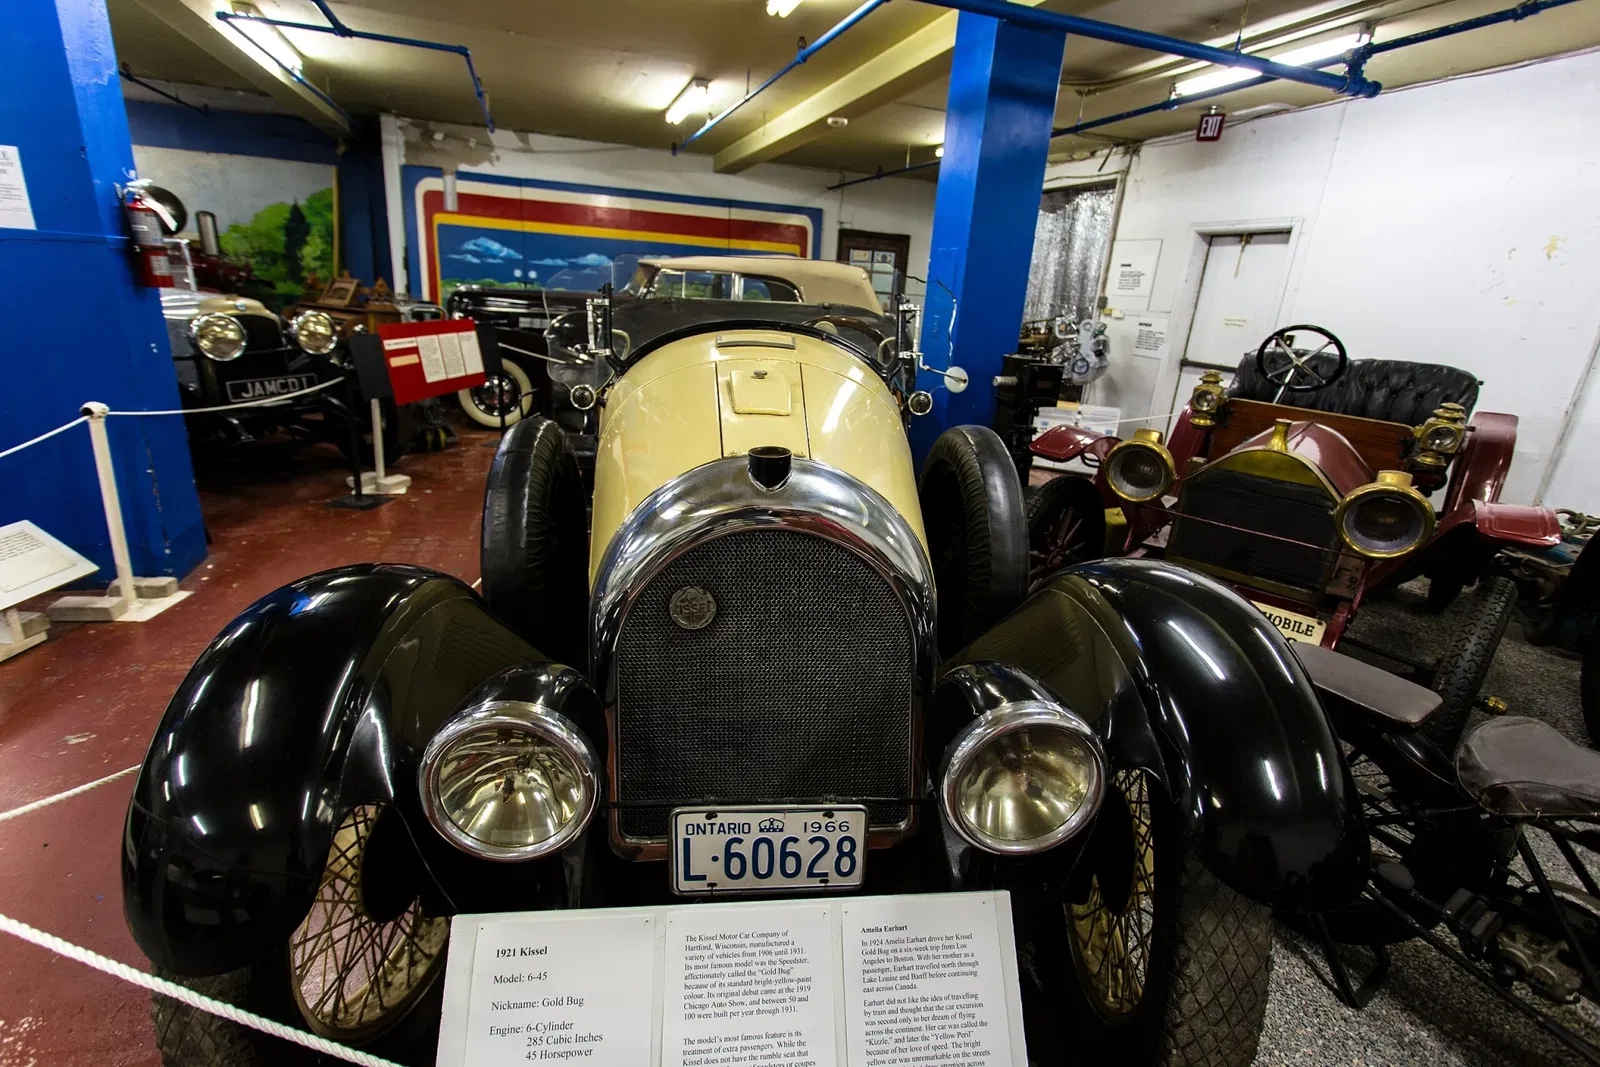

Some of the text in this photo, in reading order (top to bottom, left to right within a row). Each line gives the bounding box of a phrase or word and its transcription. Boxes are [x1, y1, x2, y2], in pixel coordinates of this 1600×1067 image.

[1200, 116, 1222, 137] EXIT
[685, 821, 850, 836] ONTARIO 1966
[685, 934, 697, 942] The
[698, 933, 717, 942] Kissel
[718, 932, 737, 940] Motor
[751, 931, 780, 940] Company
[781, 929, 788, 937] of
[861, 923, 908, 934] Amelia Earhart
[749, 938, 789, 948] manufactured
[861, 939, 868, 947] In
[869, 938, 883, 946] 1924
[884, 937, 905, 945] Amelia
[906, 935, 926, 944] Earhart
[927, 935, 943, 943] drove
[955, 932, 973, 941] Kissel
[496, 945, 548, 958] 1921 Kissel
[685, 952, 705, 962] variety
[706, 952, 714, 960] of
[715, 951, 740, 959] vehicles
[741, 950, 756, 958] from
[757, 949, 773, 957] 1906
[774, 948, 788, 956] until
[861, 947, 876, 956] Gold
[877, 947, 889, 956] Bug
[903, 944, 928, 953] six-week
[929, 943, 940, 953] trip
[941, 943, 955, 951] from
[956, 942, 967, 950] Los
[693, 962, 709, 970] most
[710, 961, 732, 969] famous
[734, 959, 753, 968] model
[767, 958, 777, 966] the
[862, 956, 885, 966] Angeles
[916, 953, 930, 961] With
[942, 951, 962, 960] mother
[893, 963, 914, 972] Earhart
[915, 961, 940, 971] travelled
[941, 960, 956, 969] north
[957, 959, 979, 969] through
[493, 971, 548, 984] Model: 6-45
[684, 971, 726, 980] affectionately
[727, 969, 745, 978] called
[747, 969, 756, 977] the
[862, 969, 978, 983] Lake Louise and Banff before continuing
[684, 982, 708, 990] because
[709, 980, 716, 988] of
[717, 980, 725, 988] its
[726, 978, 752, 987] standard
[863, 985, 874, 993] east
[706, 991, 715, 999] Its
[716, 989, 740, 999] original
[741, 988, 758, 996] debut
[777, 986, 783, 994] at
[784, 986, 794, 994] the
[795, 984, 811, 993] 1919
[491, 996, 584, 1011] Nickname: Gold Bug
[683, 1002, 709, 1011] Chicago
[710, 1000, 727, 1008] Auto
[748, 997, 760, 1006] and
[761, 997, 787, 1005] between
[788, 995, 796, 1003] 50
[797, 994, 809, 1002] and
[863, 998, 884, 1007] Earhart
[885, 997, 895, 1005] did
[896, 997, 906, 1005] not
[907, 996, 918, 1004] like
[919, 995, 929, 1003] the
[930, 994, 942, 1002] idea
[943, 993, 950, 1001] of
[684, 1012, 695, 1020] 100
[713, 1010, 728, 1018] built
[729, 1011, 739, 1019] per
[740, 1010, 754, 1018] year
[755, 1006, 780, 1016] through
[489, 1021, 574, 1037] Engine: 6-Cylinder
[526, 1032, 603, 1047] 285 Cubic Inches
[683, 1037, 695, 1046] The
[723, 1034, 739, 1043] most
[764, 1031, 786, 1040] feature
[787, 1030, 793, 1038] is
[525, 1049, 593, 1060] 45 Horsepower
[682, 1046, 712, 1056] treatment
[713, 1046, 720, 1054] of
[722, 1045, 738, 1053] extra
[776, 1040, 795, 1049] While
[796, 1039, 806, 1047] the
[682, 1049, 809, 1067] Kissel does not have the rumble seat that
[866, 1057, 886, 1067] yellow
[961, 1050, 970, 1058] the
[971, 1048, 990, 1057] streets
